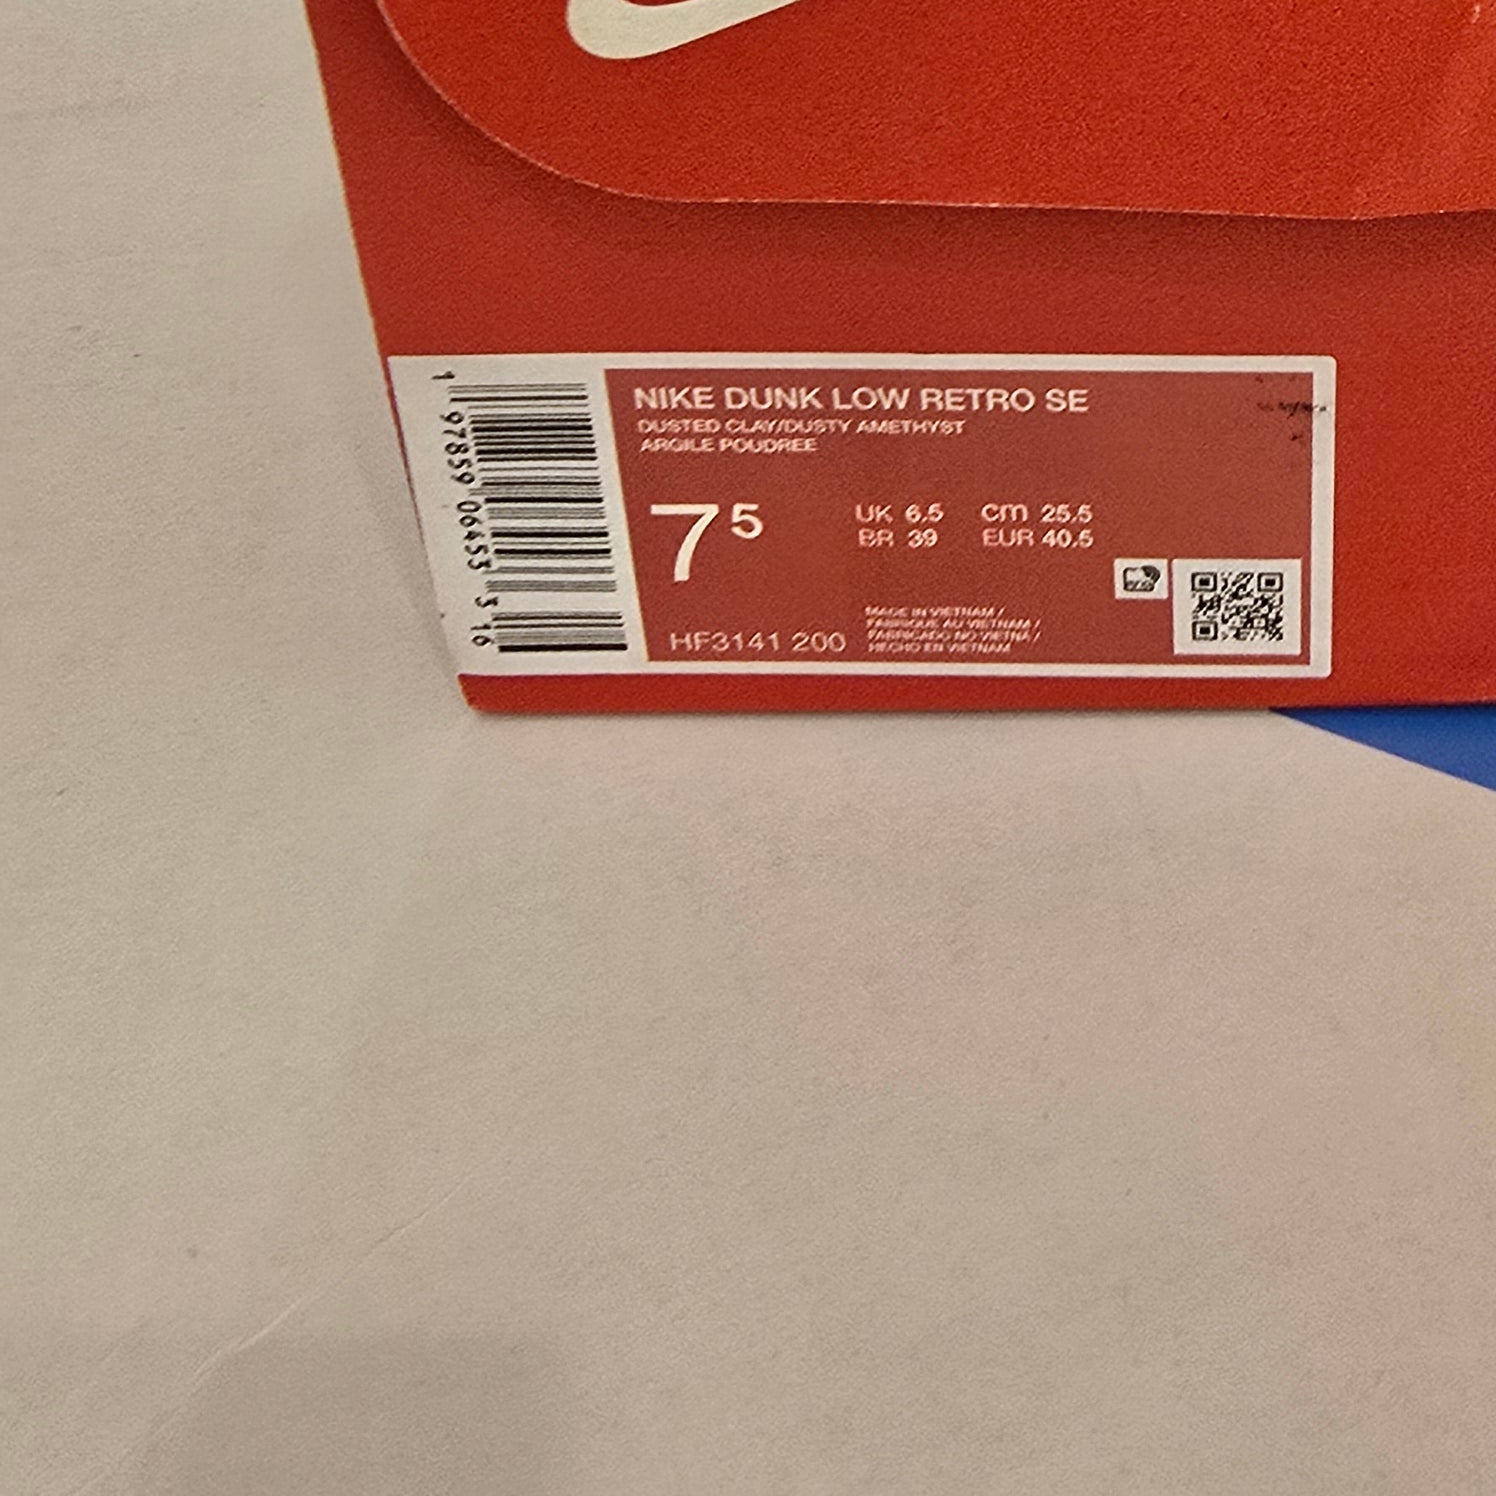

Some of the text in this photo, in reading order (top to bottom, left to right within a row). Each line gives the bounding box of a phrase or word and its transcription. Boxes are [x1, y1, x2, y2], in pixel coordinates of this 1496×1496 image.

[634, 386, 1090, 412] NIKE DUNK LOW RETRO SE
[637, 418, 966, 435] DUSTED CLAY/DUSTY AMETHYST
[440, 410, 476, 485] 97859
[641, 437, 716, 452] ARGILE
[855, 504, 894, 524] UK
[905, 503, 944, 523] 6.5
[1041, 503, 1093, 524] 25.5
[457, 500, 492, 570] 06453
[858, 528, 1094, 549] BR 39 EUR 40.5
[670, 631, 847, 653] HF3141 200
